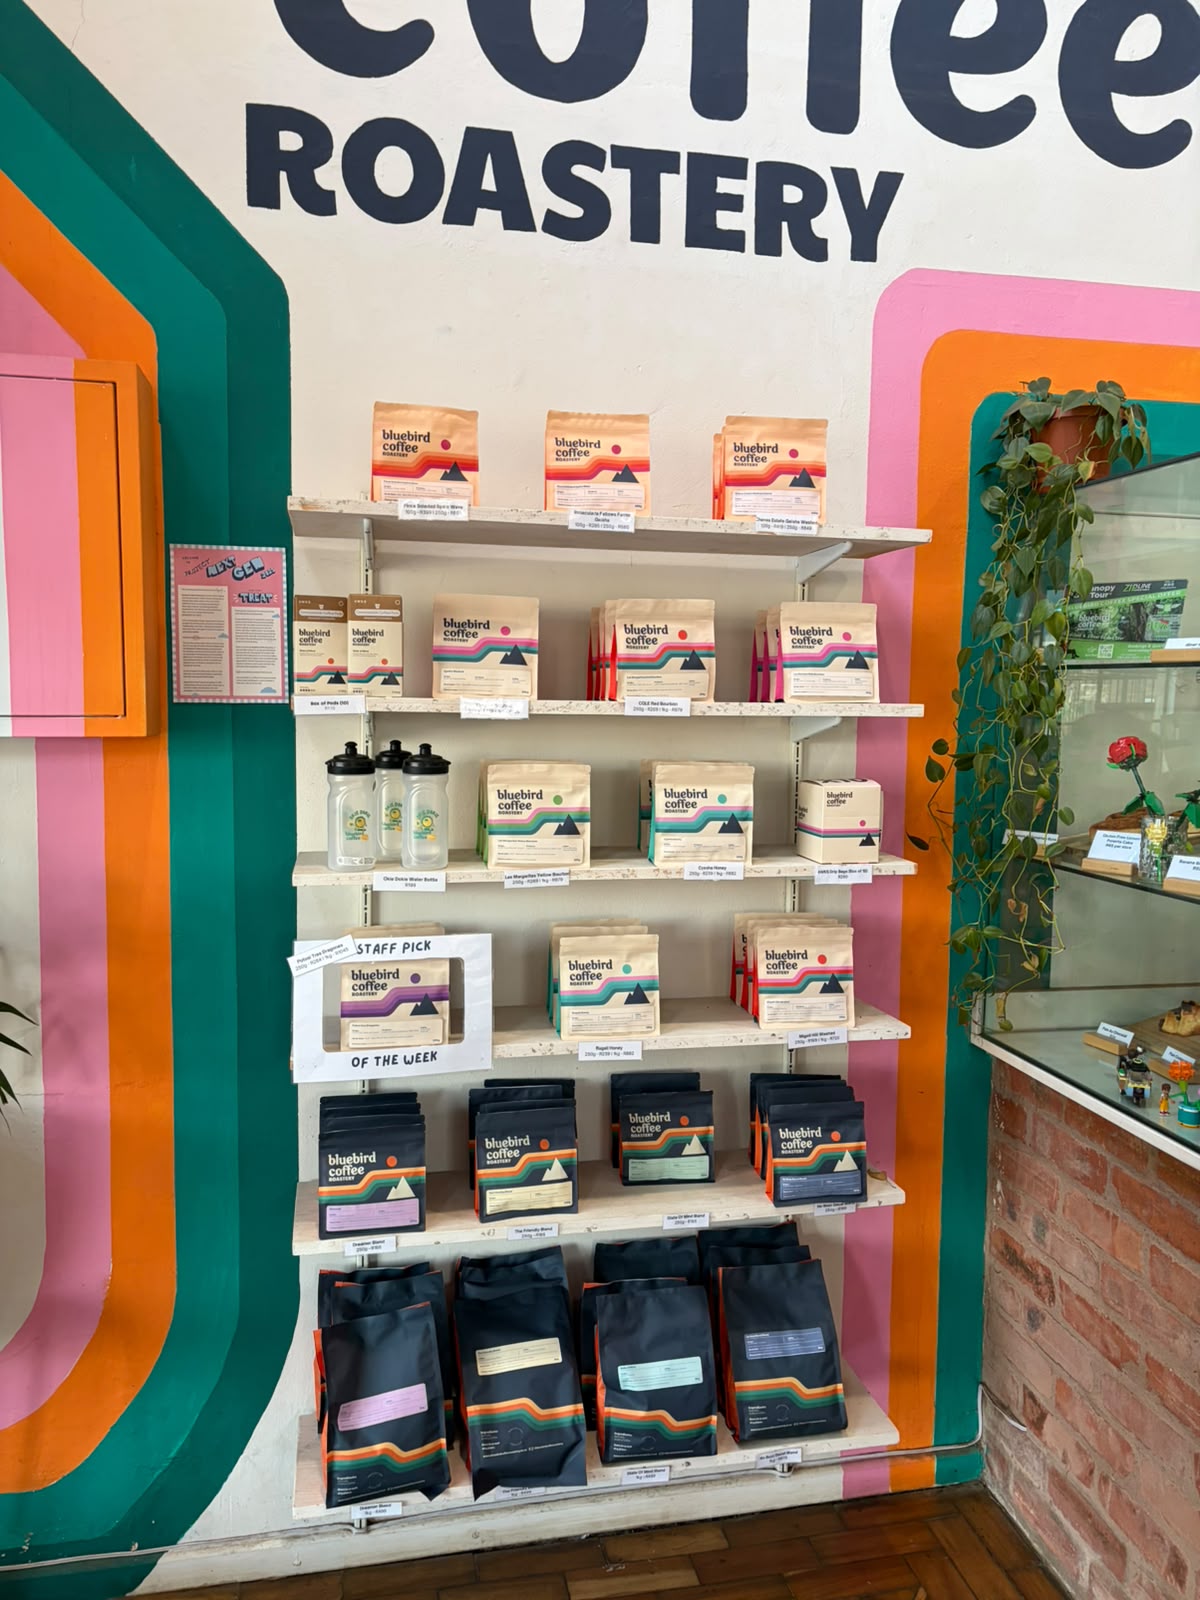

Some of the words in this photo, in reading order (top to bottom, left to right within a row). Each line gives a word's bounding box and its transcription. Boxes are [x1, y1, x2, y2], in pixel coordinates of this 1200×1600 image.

[244, 101, 902, 263] ROASTERY
[382, 429, 431, 443] bluebird
[382, 441, 418, 454] coffee
[555, 437, 601, 449] bluebird
[733, 442, 779, 454] bluebird
[555, 447, 590, 458] coffee
[734, 453, 767, 463] coffee
[206, 555, 237, 578] NEXT
[231, 556, 265, 581] GEN
[238, 592, 274, 604] TREAT
[443, 617, 490, 630] bluebird
[298, 628, 331, 637] bluebird
[352, 628, 384, 637] bluebird
[443, 629, 479, 639] coffee
[623, 624, 669, 635] bluebird
[789, 626, 833, 636] bluebird
[299, 636, 323, 644] coffee
[352, 636, 377, 644] coffee
[625, 635, 658, 645] coffee
[791, 636, 823, 645] coffee
[497, 789, 543, 800] bluebird
[663, 788, 708, 799] bluebird
[826, 791, 853, 799] bluebird
[498, 800, 532, 811] coffee
[664, 799, 698, 809] coffee
[826, 797, 846, 805] coffee
[356, 942, 397, 955] STAFF
[402, 939, 432, 954] PICK
[765, 949, 808, 960] bluebird
[568, 959, 613, 971] bluebird
[766, 960, 798, 970] coffee
[351, 968, 400, 981] bluebird
[569, 971, 603, 981] coffee
[351, 980, 388, 992] coffee
[351, 1057, 369, 1069] OF
[374, 1054, 399, 1067] THE
[403, 1051, 438, 1065] WEEK
[628, 1111, 671, 1124] bluebird
[630, 1123, 662, 1133] coffee
[778, 1126, 822, 1139] bluebird
[484, 1134, 531, 1149] bluebird
[781, 1138, 813, 1150] coffee
[328, 1151, 377, 1166] bluebird
[486, 1148, 520, 1160] coffee
[328, 1165, 365, 1177] coffee
